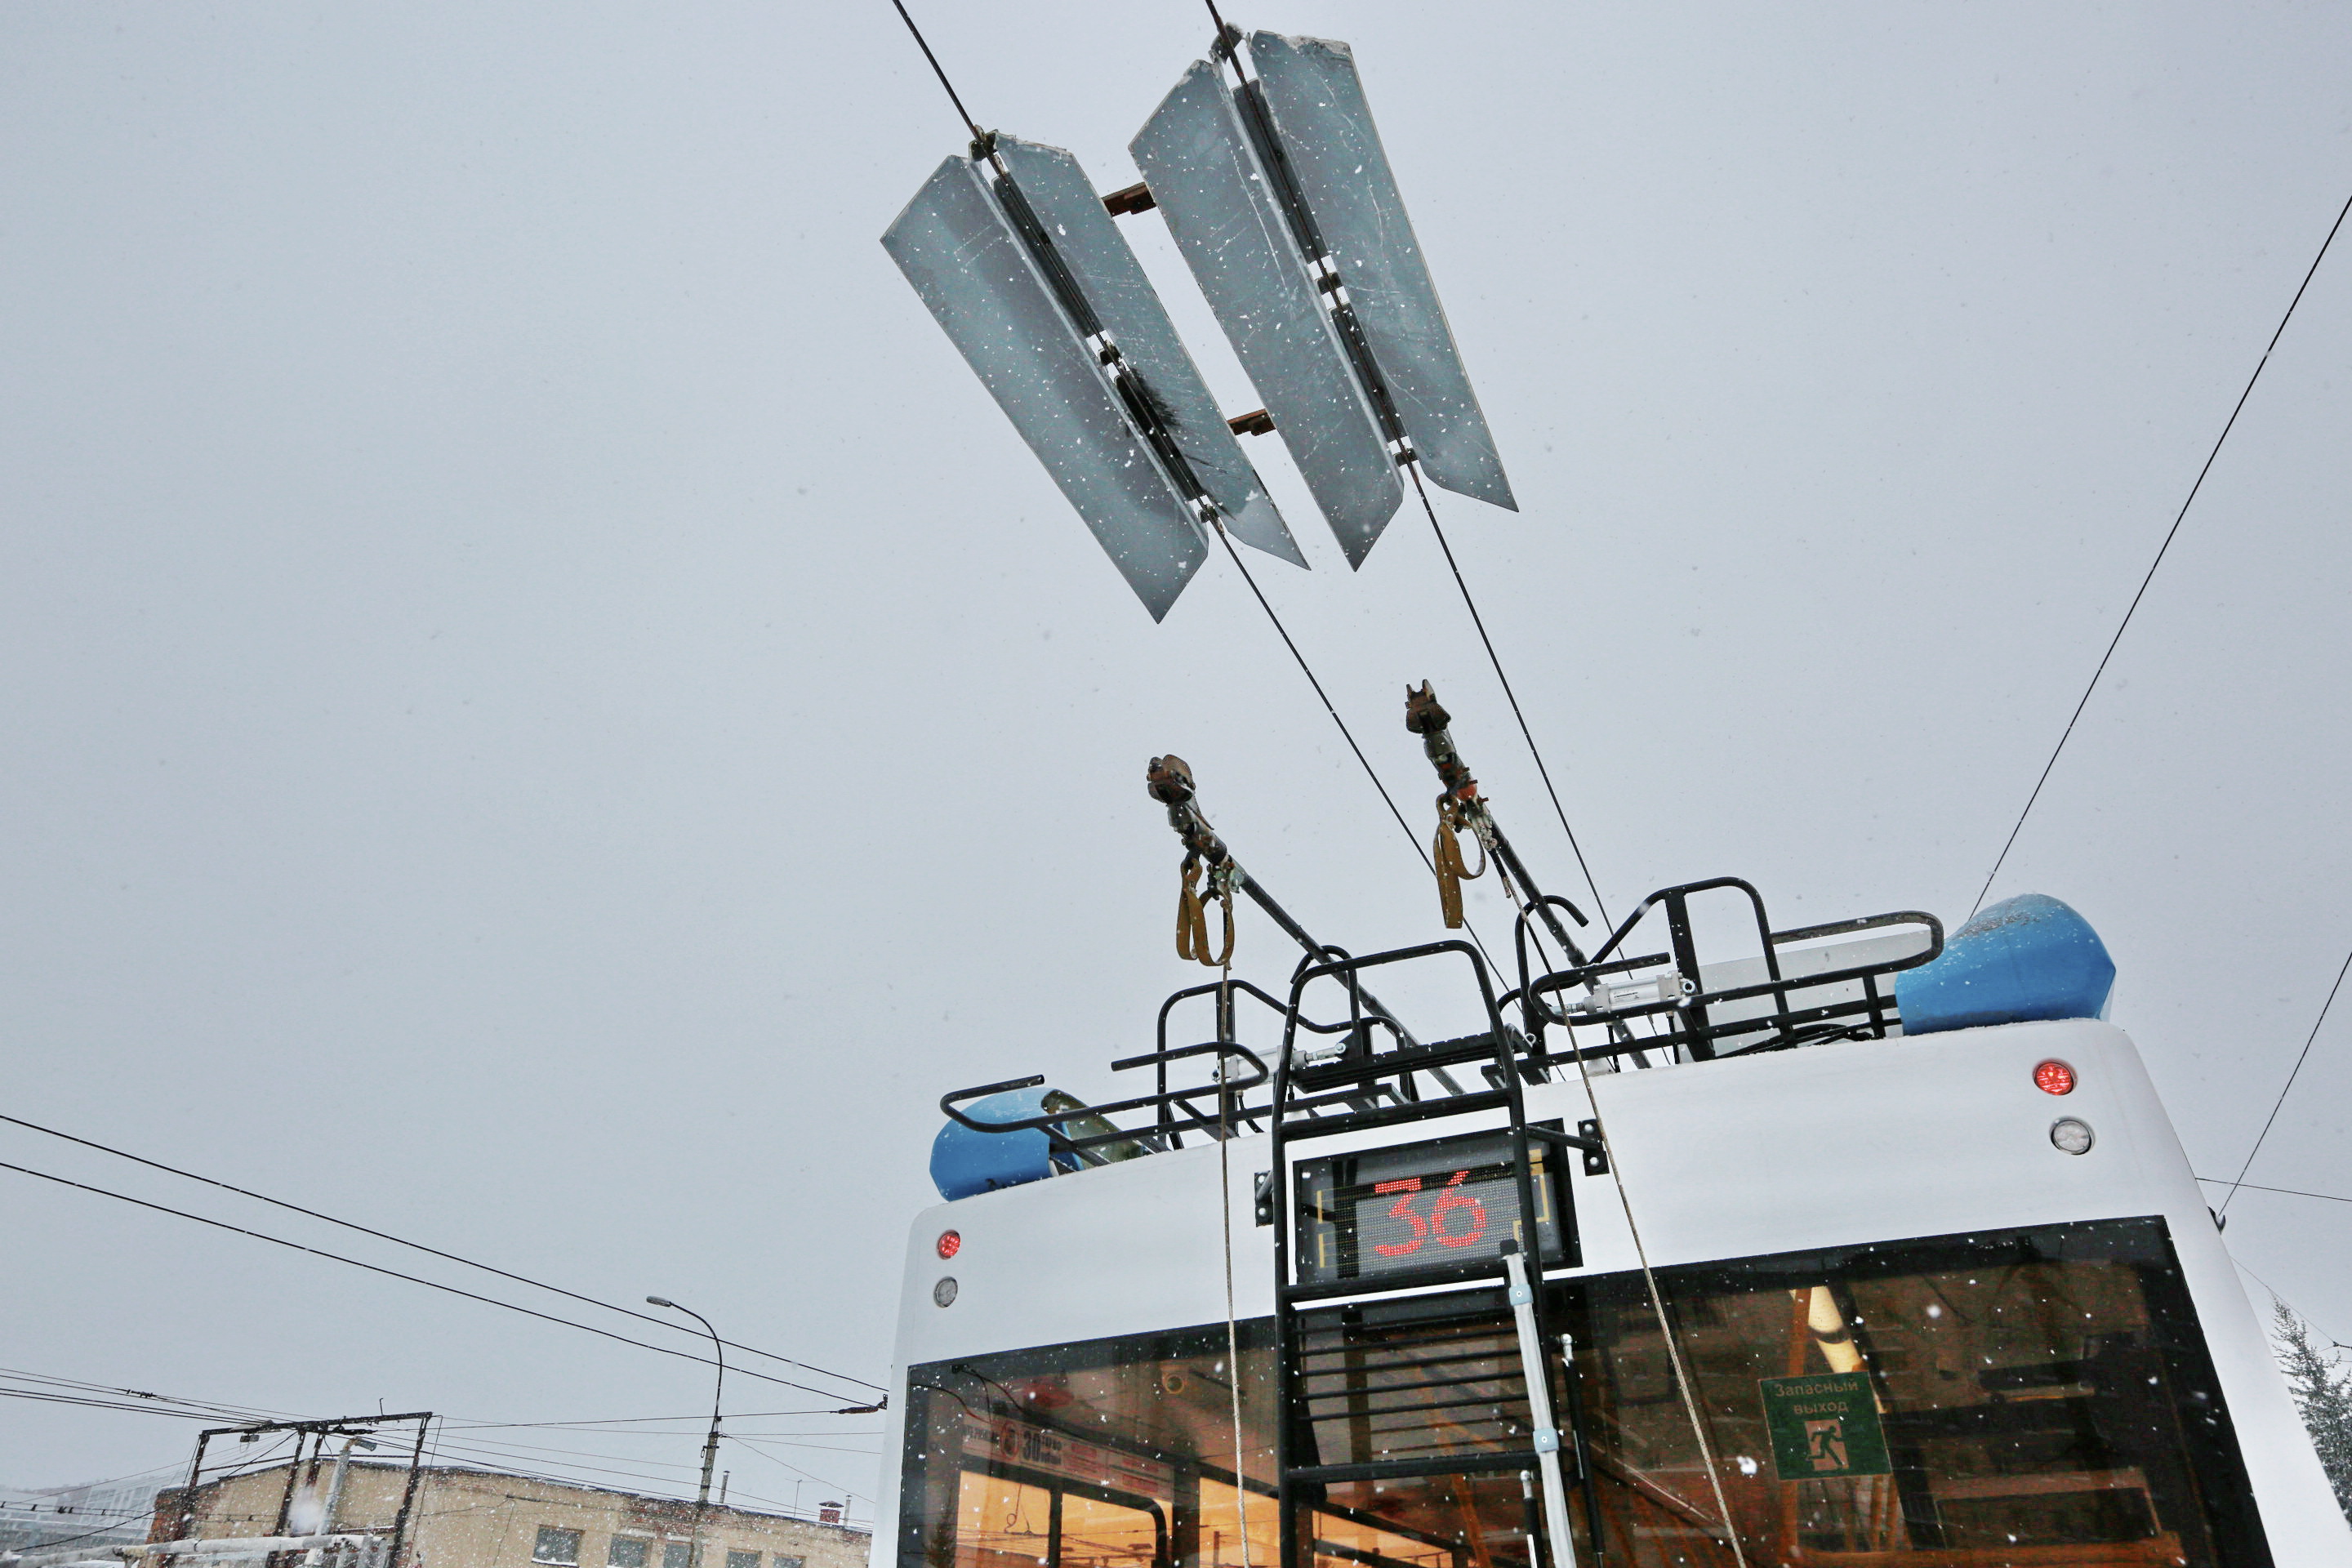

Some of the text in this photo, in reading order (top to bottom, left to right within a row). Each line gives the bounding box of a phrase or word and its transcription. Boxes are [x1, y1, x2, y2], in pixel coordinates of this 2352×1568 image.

[1374, 1169, 1486, 1257] 36
[1774, 1379, 1859, 1397] Запасный
[1793, 1401, 1849, 1414] выход
